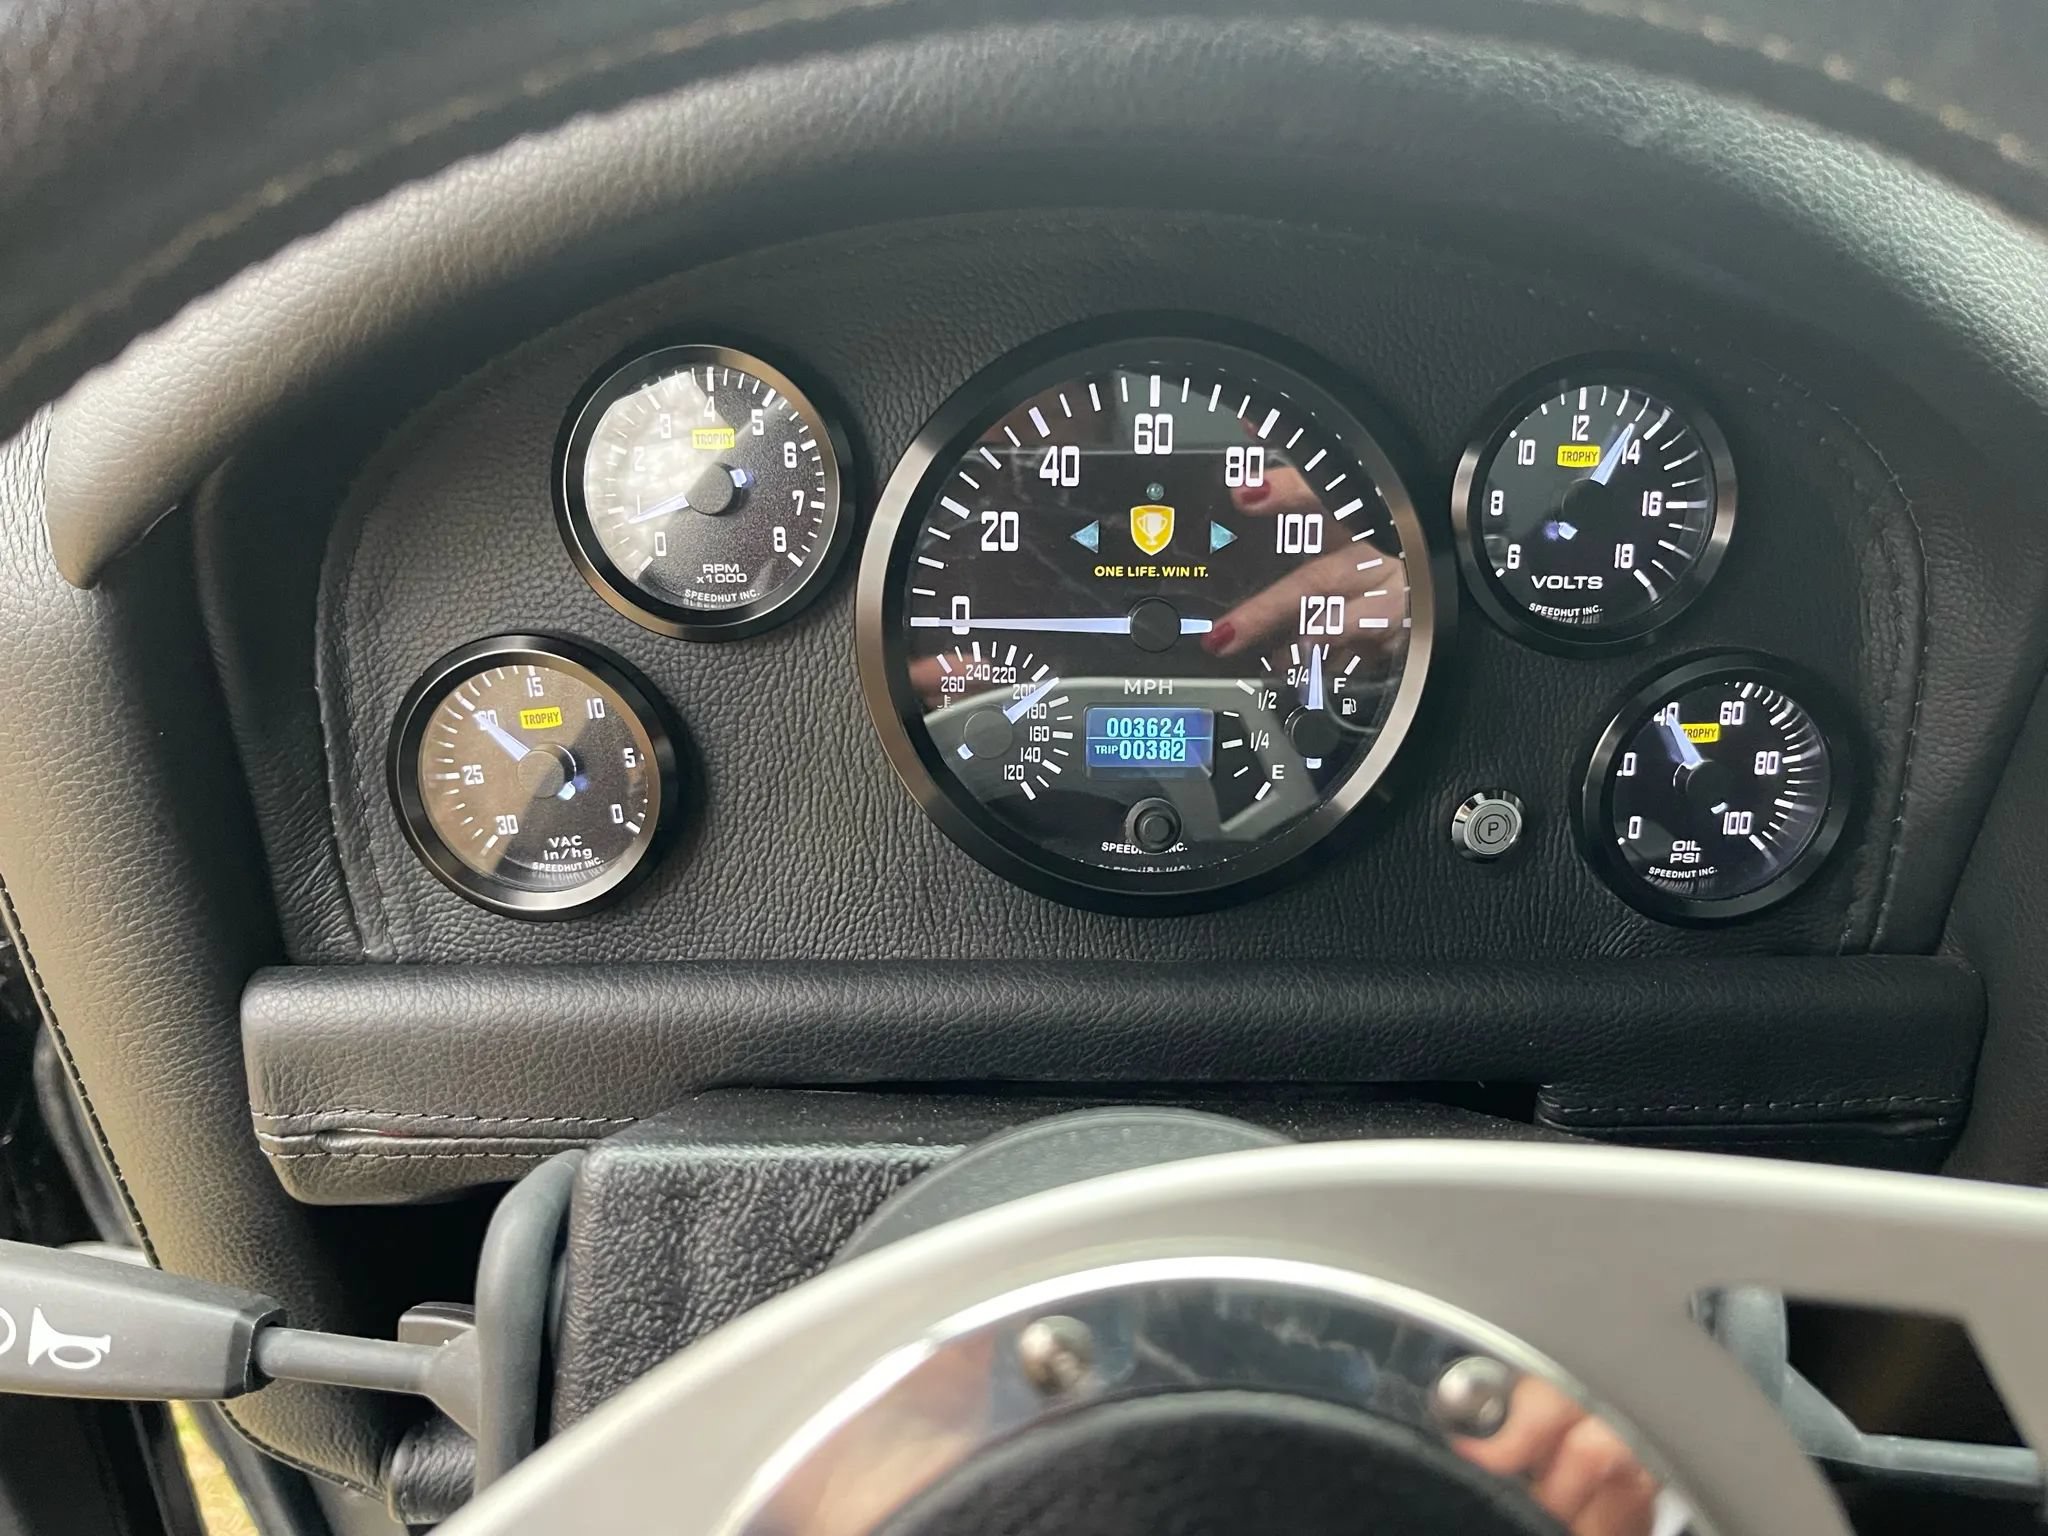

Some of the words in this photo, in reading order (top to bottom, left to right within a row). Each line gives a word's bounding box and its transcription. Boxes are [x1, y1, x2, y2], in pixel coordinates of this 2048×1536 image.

[703, 396, 716, 422] 4
[660, 414, 671, 438] 3
[751, 409, 764, 436] 5
[1571, 415, 1590, 441] 12
[696, 431, 733, 445] TROPHY
[1134, 413, 1173, 455] 60
[634, 446, 646, 471] 2
[784, 441, 797, 468] 6
[1517, 439, 1536, 465] 10
[1561, 450, 1598, 463] TROPHY
[1621, 439, 1641, 464] 14
[1039, 446, 1080, 487] 40
[1225, 446, 1264, 487] 80
[792, 490, 804, 516] 7
[1490, 490, 1504, 516] 8
[1642, 490, 1662, 517] 16
[773, 527, 786, 552] 8
[981, 511, 1019, 551] 20
[1276, 513, 1323, 554] 100
[655, 532, 666, 556] 0
[1507, 543, 1521, 570] 6
[1614, 543, 1635, 569] 18
[696, 573, 747, 583] x1000
[702, 563, 740, 573] RPM
[1094, 566, 1124, 577] ONE
[1127, 566, 1160, 577] LIFE.
[1162, 566, 1190, 577] WIN
[1194, 566, 1209, 577] IT.
[1531, 575, 1603, 589] VOLTS
[684, 589, 737, 603] SPEEDHUT
[739, 589, 760, 601] INC.
[952, 596, 970, 635] 0
[1299, 596, 1344, 635] 120
[1529, 602, 1580, 617] SPEEDHUT
[1582, 603, 1603, 615] INC.
[966, 664, 990, 680] 240
[992, 667, 1016, 683] 220
[1287, 666, 1309, 685] 3/4
[526, 677, 544, 698] 15
[941, 677, 965, 692] 260
[1124, 679, 1174, 695] MPH
[1333, 678, 1346, 694] F
[586, 698, 605, 720] 10
[1258, 691, 1277, 711] 1/2
[524, 712, 559, 725] TROPHY
[1653, 701, 1679, 726] 40
[1719, 700, 1745, 726] 60
[1029, 726, 1049, 742] 160
[1106, 717, 1185, 738] 003624
[1095, 745, 1118, 755] TRIP
[1119, 739, 1186, 761] 00382
[1250, 730, 1270, 751] 1/4
[623, 747, 636, 768] 5
[1020, 747, 1041, 763] 140
[1617, 752, 1637, 777] 0
[1754, 750, 1779, 776] 80
[462, 764, 485, 785] 25
[1004, 764, 1024, 780] 120
[1272, 764, 1285, 779] E
[609, 803, 624, 824] 0
[1723, 811, 1753, 835] 100
[495, 814, 519, 835] 30
[1488, 822, 1499, 836] P
[1628, 816, 1642, 839] 0
[548, 834, 582, 848] VAC
[1101, 842, 1144, 855] SPEED
[1672, 840, 1701, 851] OIL
[532, 861, 582, 872] SPEEDHUT
[584, 856, 604, 868] INC.
[543, 847, 592, 860] in/hg
[1670, 853, 1700, 863] PSI
[1649, 866, 1697, 879] SPEEDHUT
[1699, 866, 1718, 877] INC.
